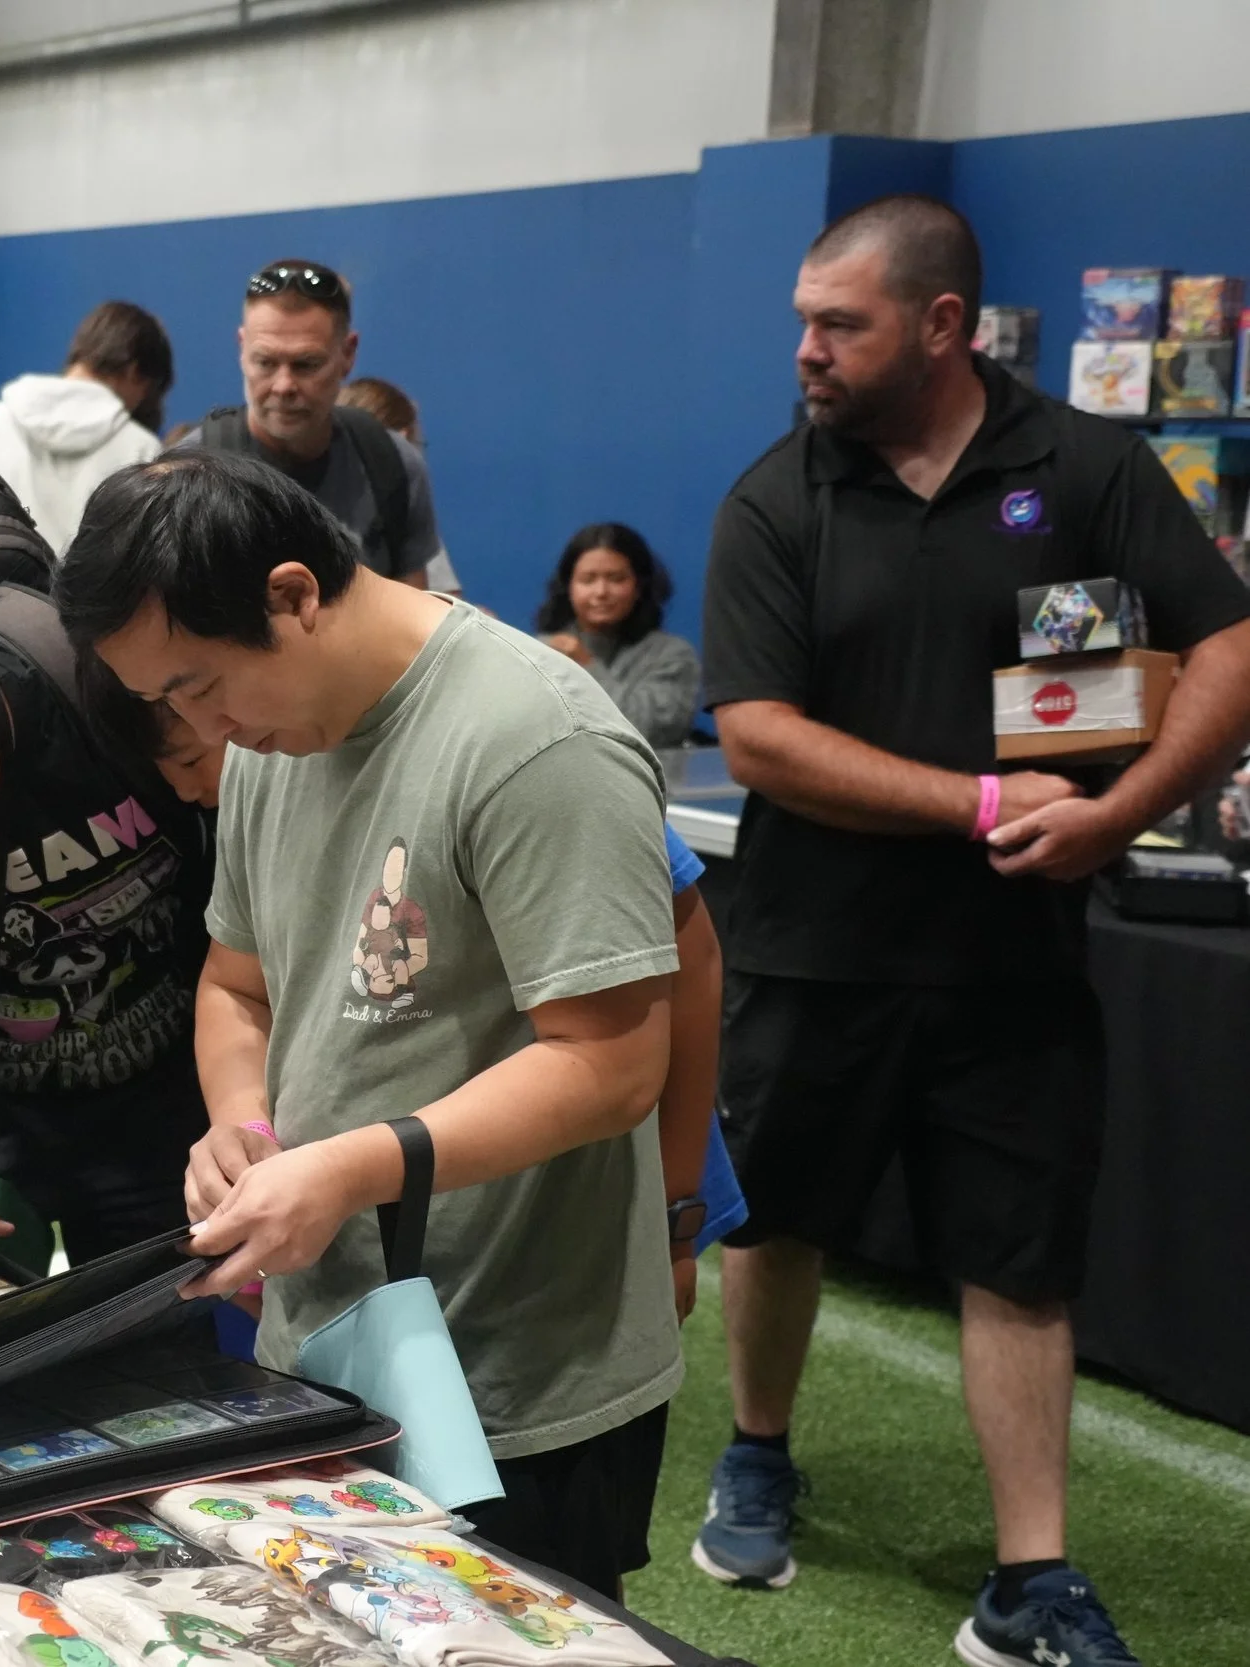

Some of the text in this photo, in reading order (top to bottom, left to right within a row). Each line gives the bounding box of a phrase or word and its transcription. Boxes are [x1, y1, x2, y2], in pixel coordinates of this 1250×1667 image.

[343, 1003, 433, 1023] Dad & Emma
